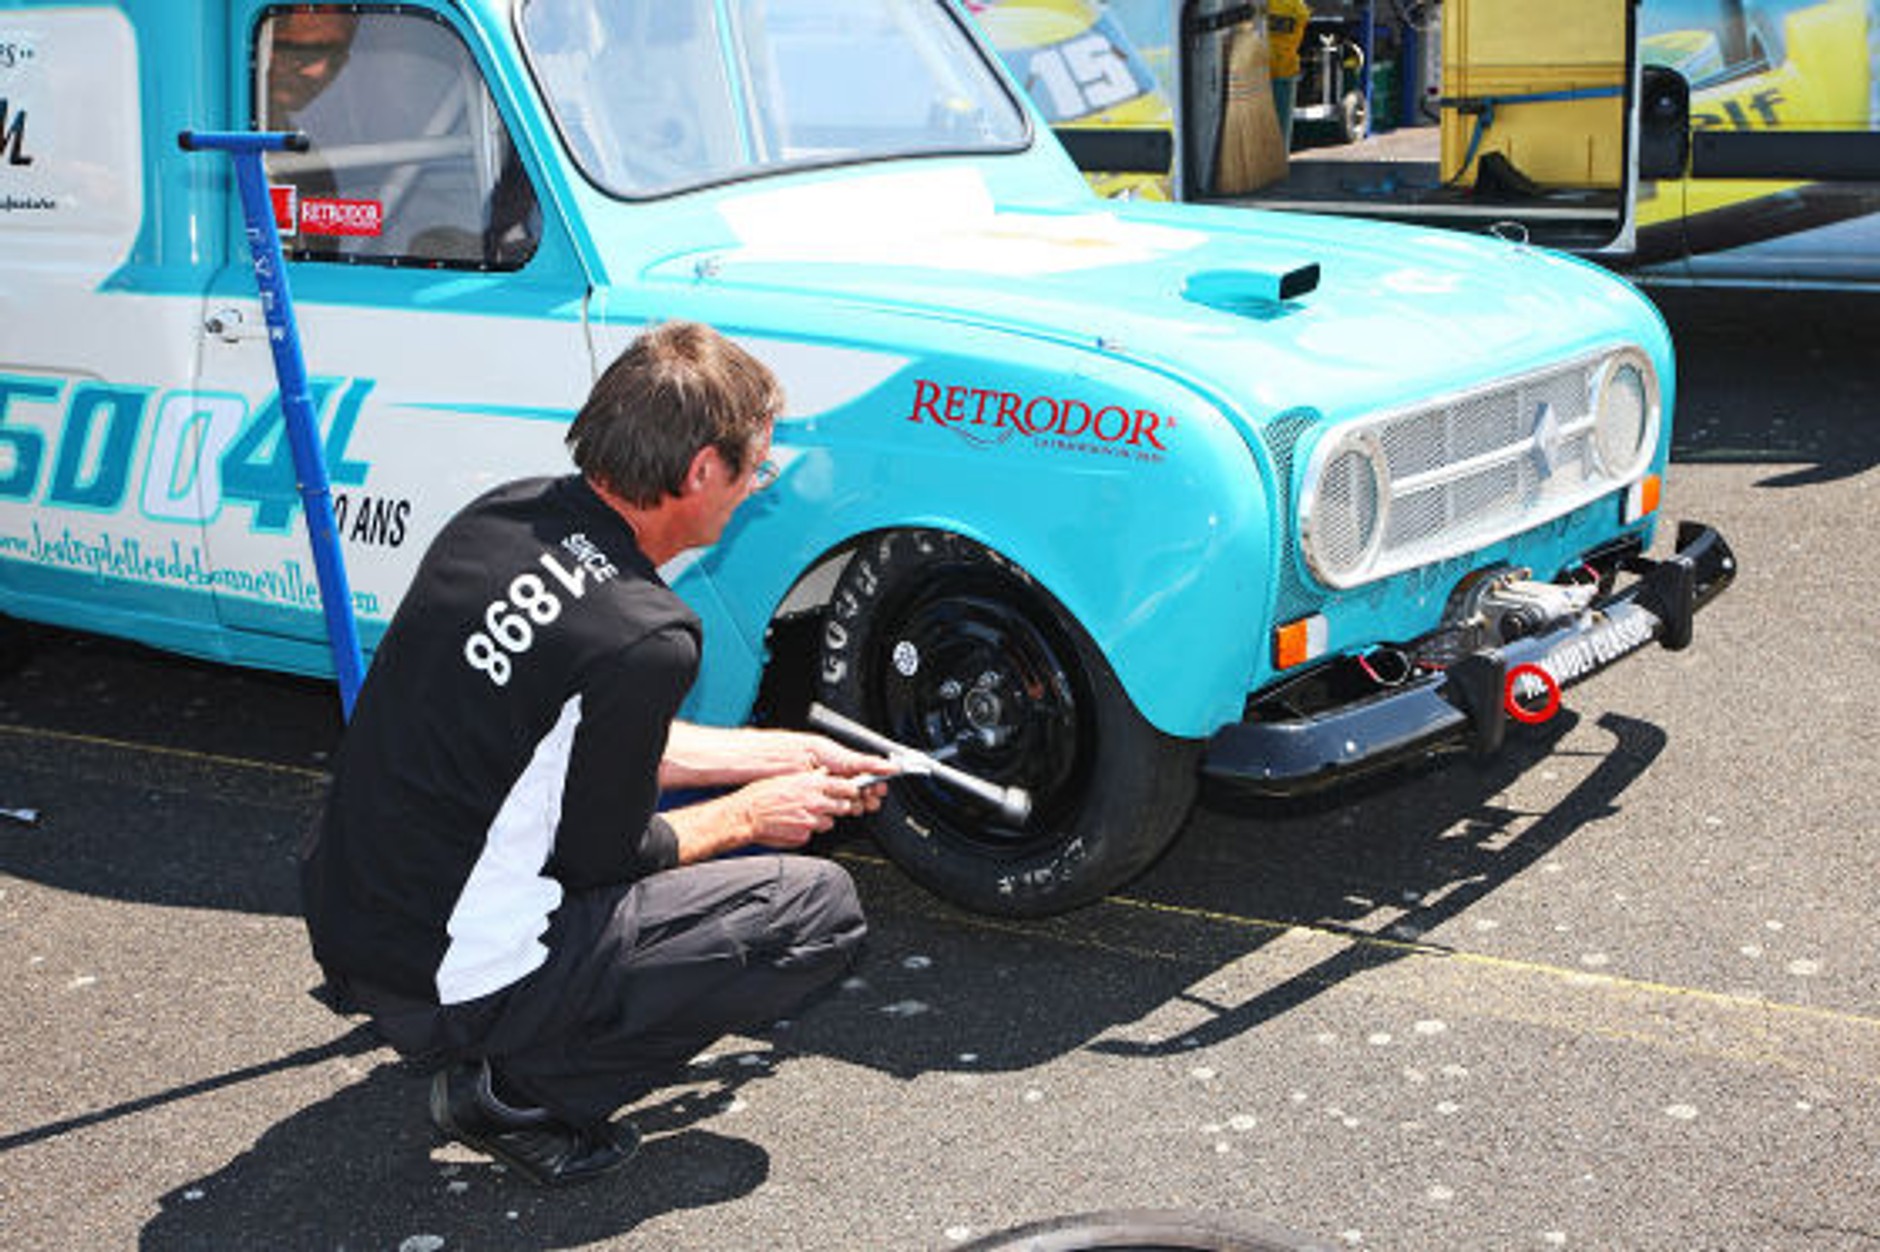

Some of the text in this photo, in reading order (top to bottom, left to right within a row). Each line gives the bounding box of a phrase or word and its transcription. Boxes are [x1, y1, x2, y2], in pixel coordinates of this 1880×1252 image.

[1029, 33, 1138, 118] 15
[350, 496, 410, 547] ANS
[464, 553, 584, 686] 1898
